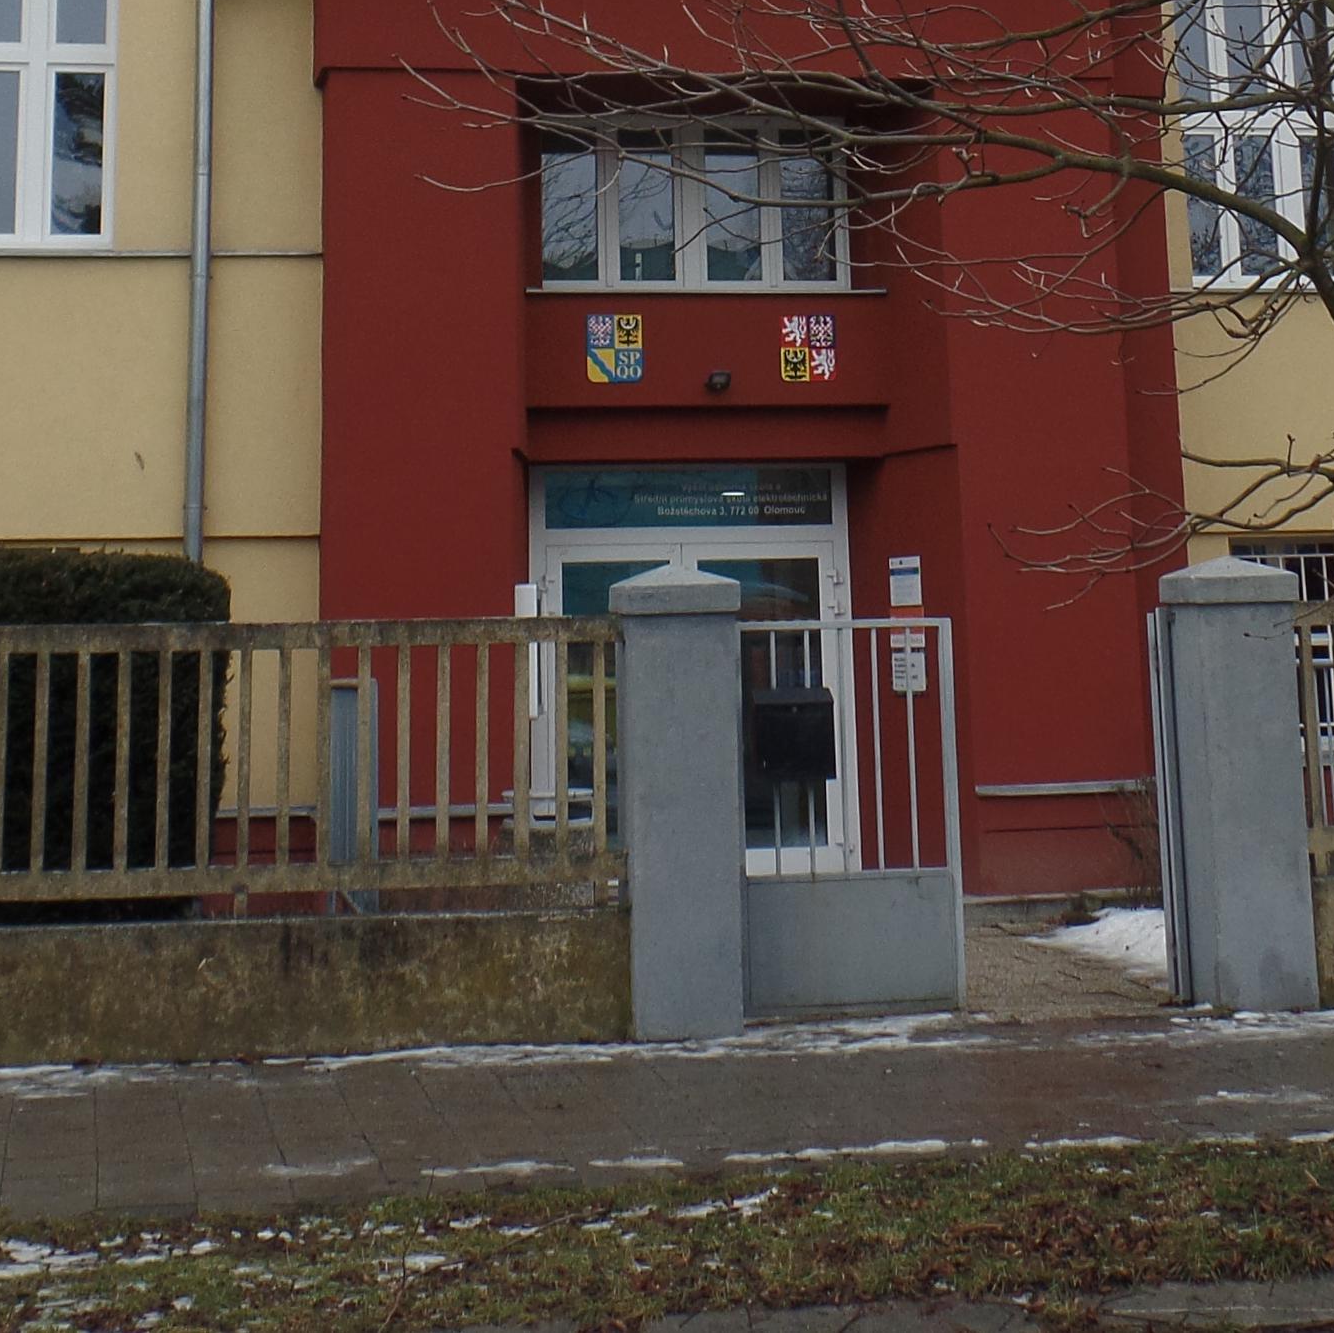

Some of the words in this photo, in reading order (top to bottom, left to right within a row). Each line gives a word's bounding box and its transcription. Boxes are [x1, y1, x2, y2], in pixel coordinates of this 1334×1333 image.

[619, 351, 640, 364] SP
[730, 505, 746, 515] 772
[748, 505, 759, 515] 00
[763, 505, 805, 515] Olomouc
